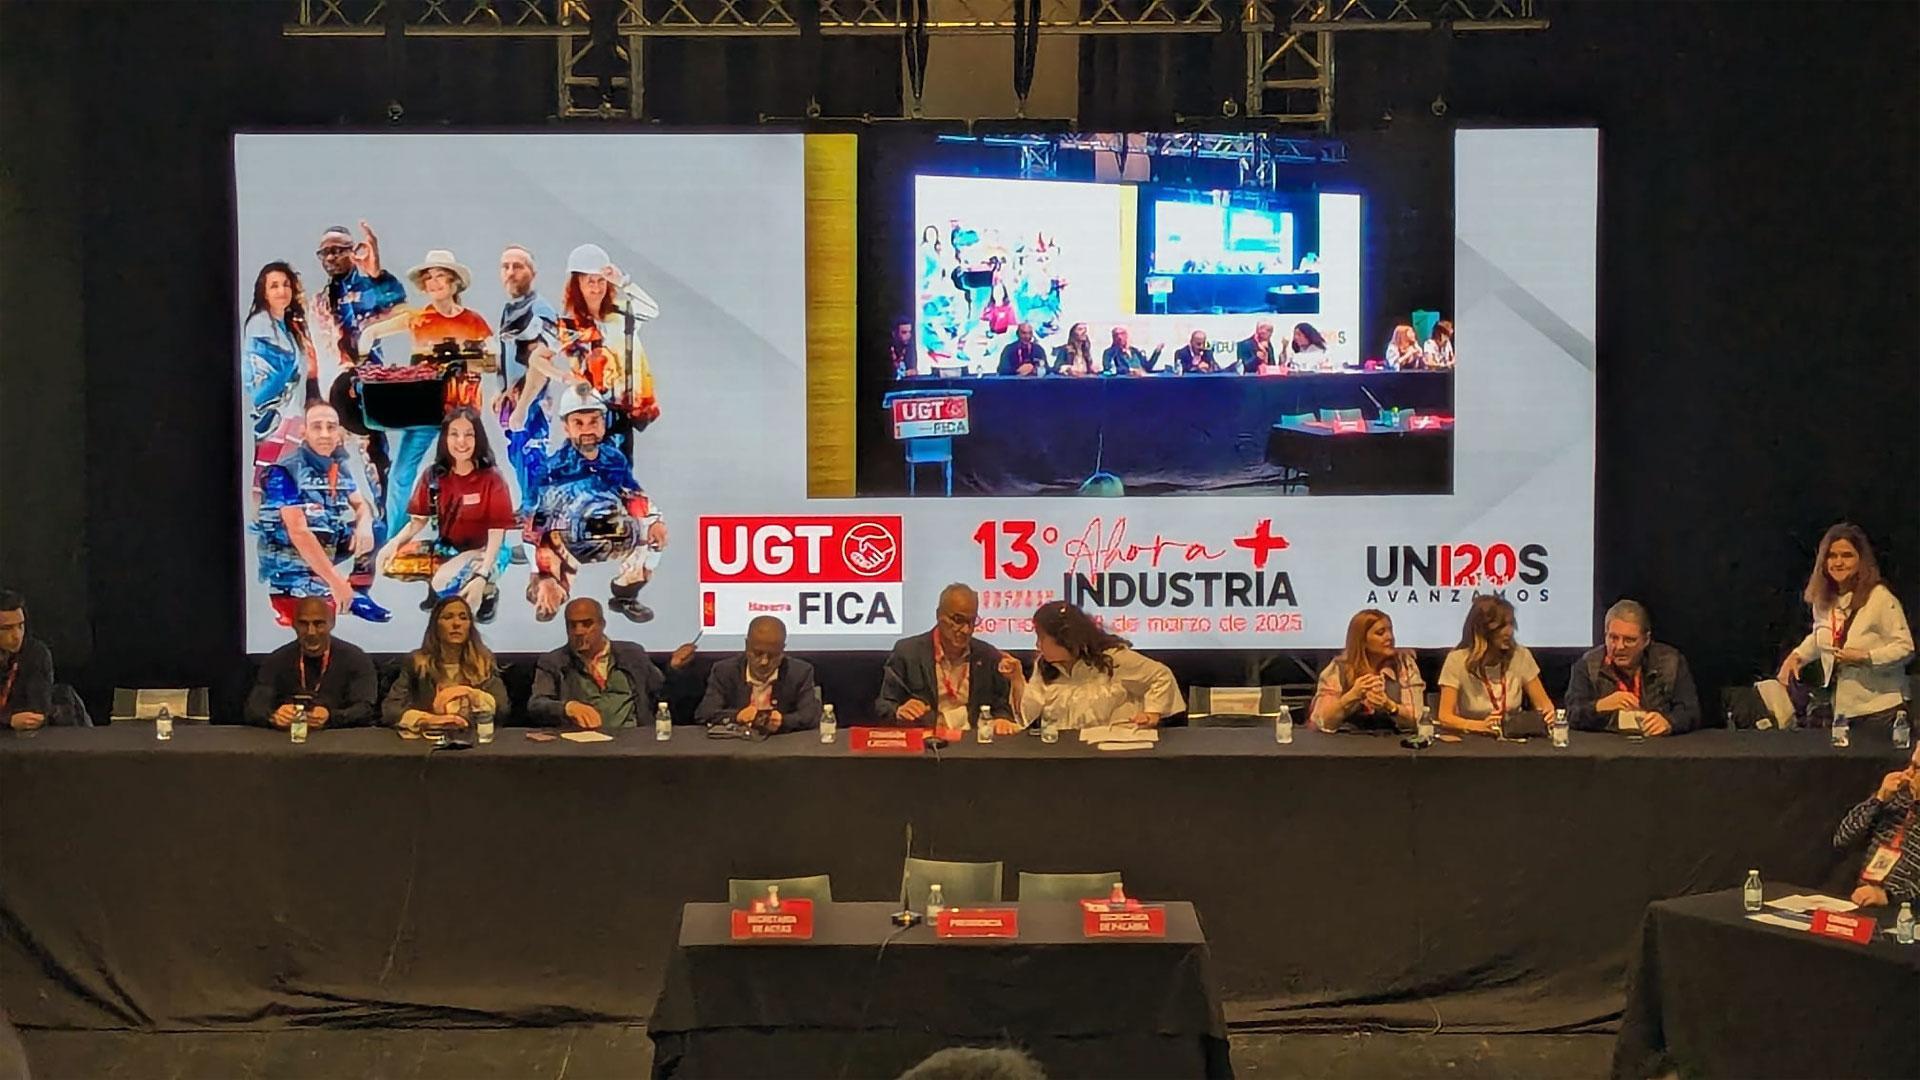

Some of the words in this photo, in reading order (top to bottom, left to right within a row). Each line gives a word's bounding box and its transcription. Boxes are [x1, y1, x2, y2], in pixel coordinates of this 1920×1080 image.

[901, 401, 944, 420] UGT
[707, 525, 833, 575] UGT
[1065, 517, 1226, 583] Ahora
[1063, 571, 1298, 608] INDUSTRIA
[799, 592, 896, 625] FICA
[1149, 616, 1211, 633] marzo
[1219, 614, 1246, 632] de
[1255, 613, 1303, 633] 2025
